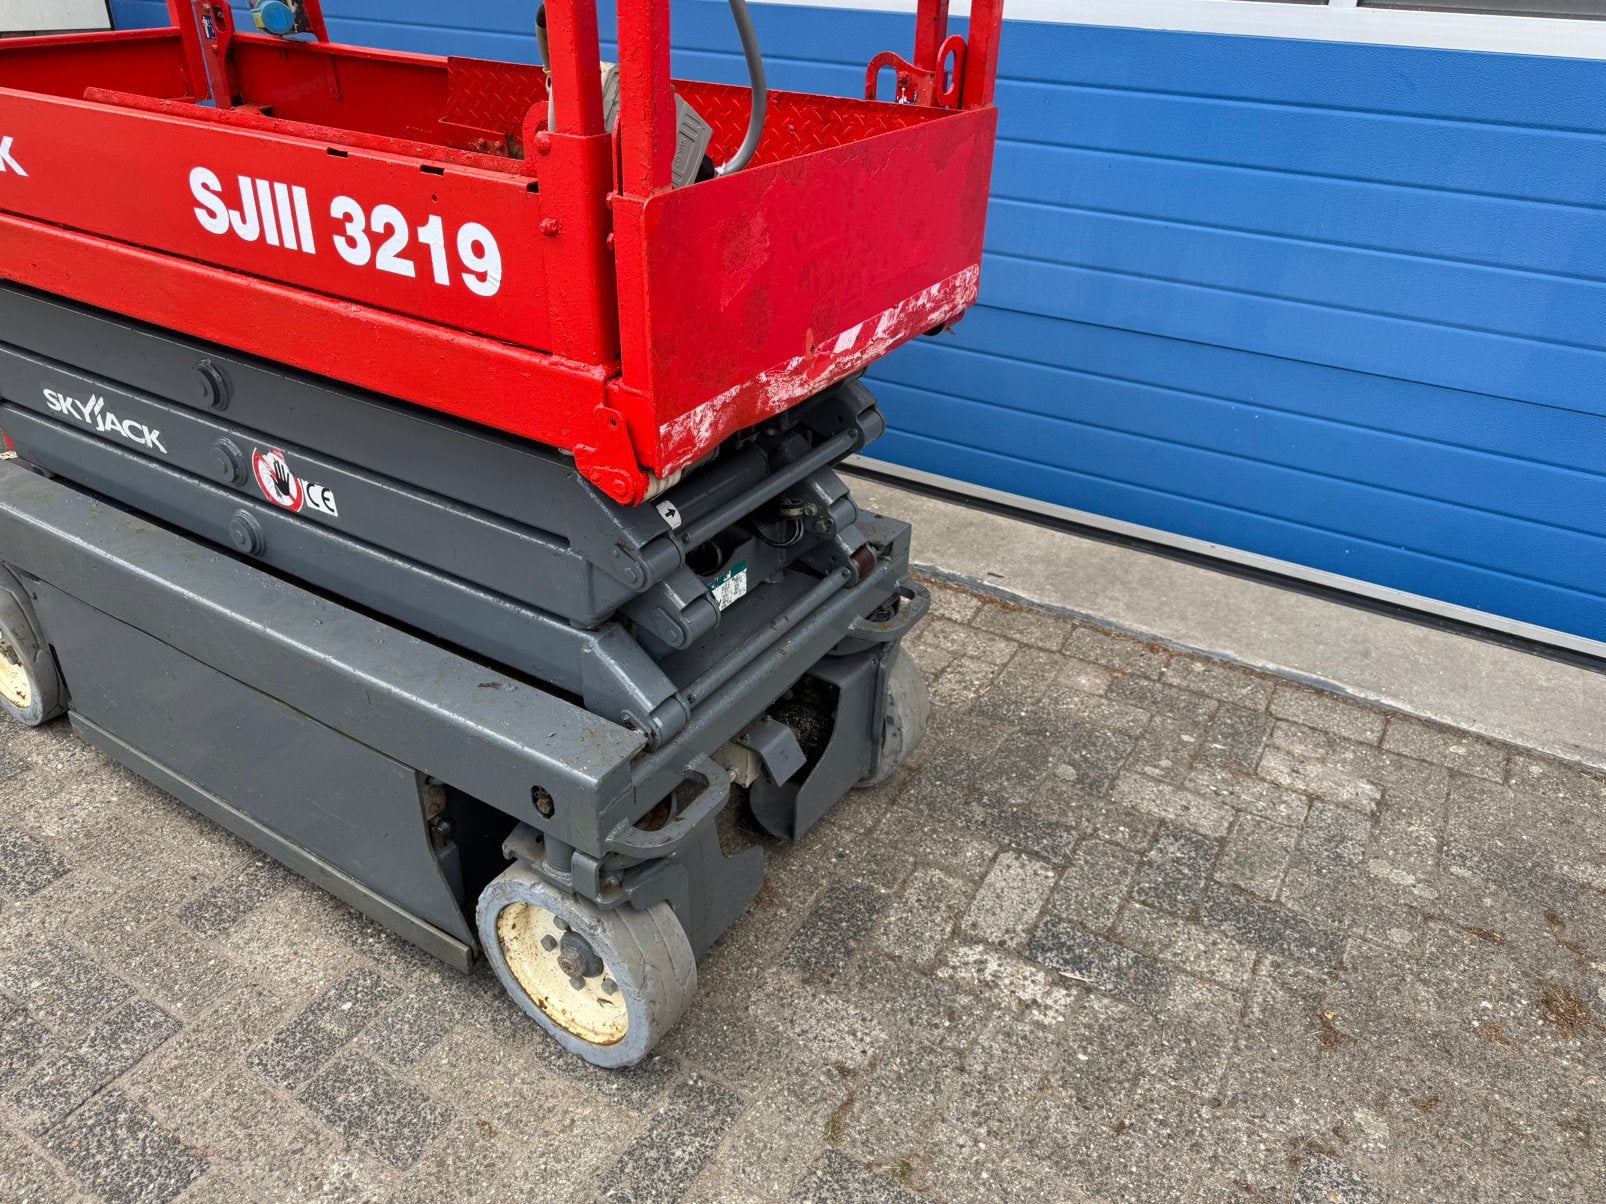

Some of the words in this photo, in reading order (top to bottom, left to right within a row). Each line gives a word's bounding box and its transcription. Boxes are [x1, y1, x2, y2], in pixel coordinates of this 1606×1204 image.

[330, 195, 502, 297] 3219
[42, 388, 168, 454] SKYJACK
[306, 482, 336, 513] CE
